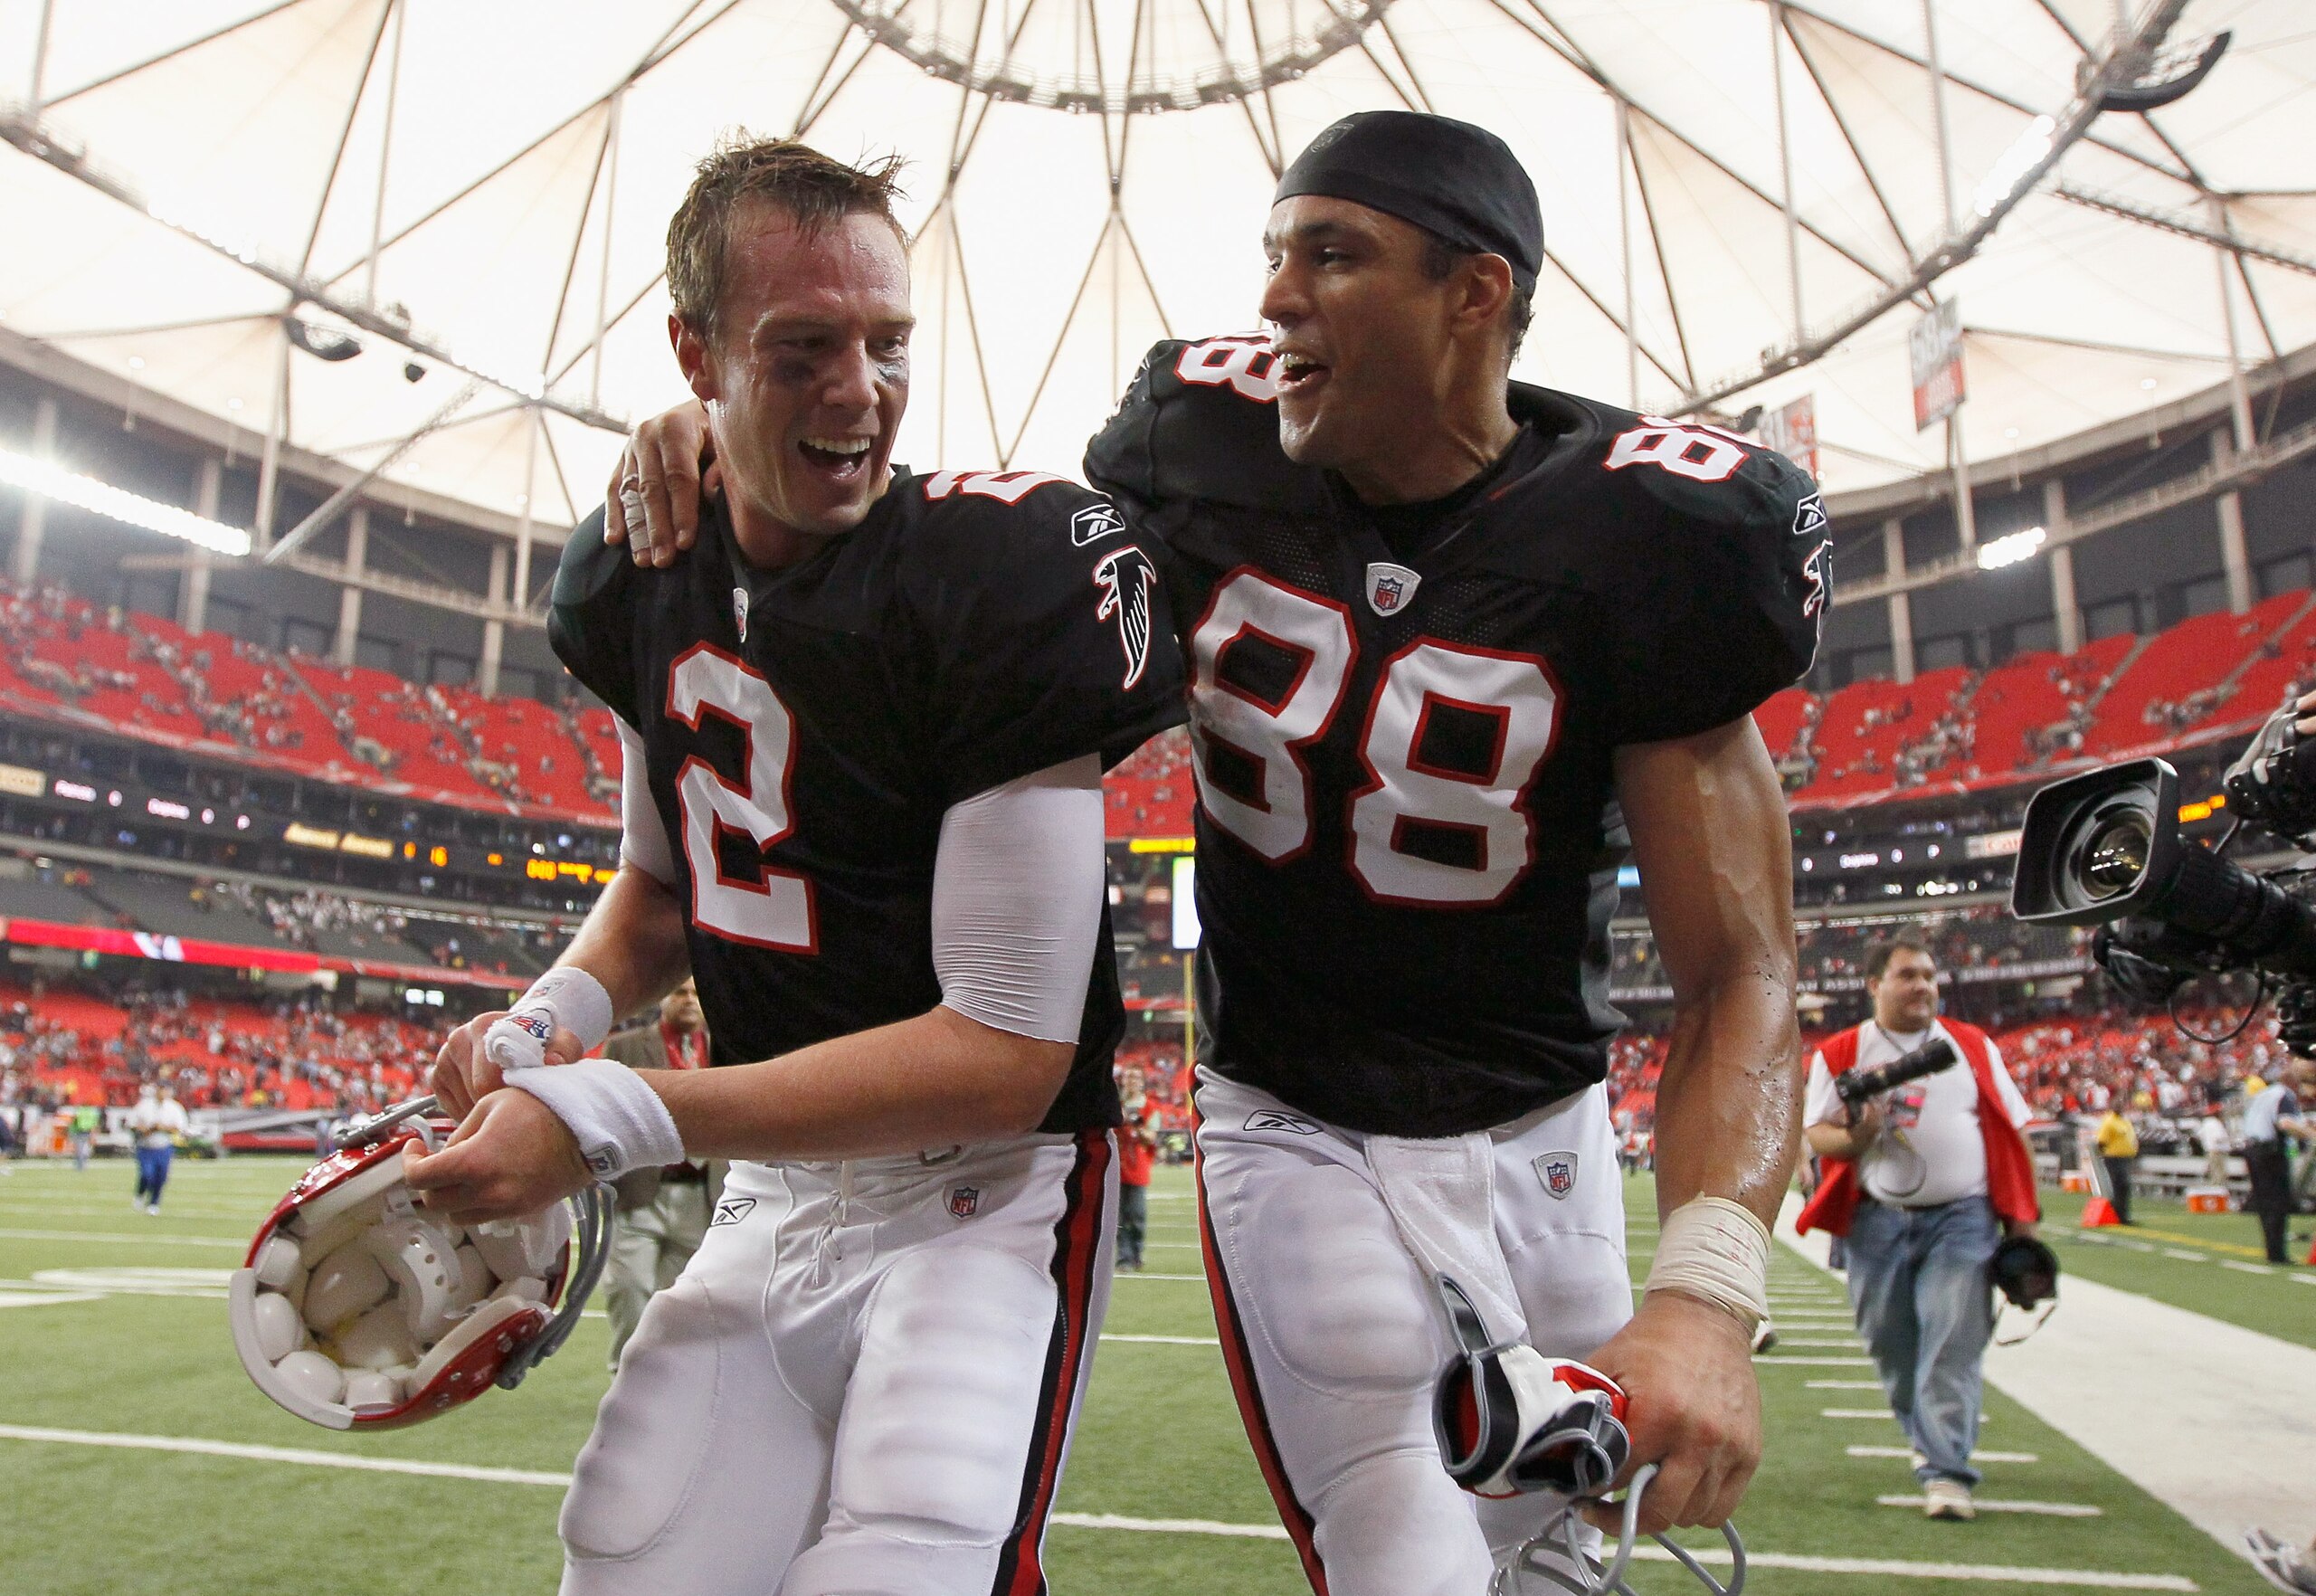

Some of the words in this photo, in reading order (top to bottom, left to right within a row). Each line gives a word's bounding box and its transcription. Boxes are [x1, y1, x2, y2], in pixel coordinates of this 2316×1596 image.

[1376, 592, 1399, 608] NFL
[1188, 565, 1563, 907] 88
[666, 641, 818, 955] 2
[1552, 1175, 1571, 1190] NFL
[953, 1199, 974, 1213] NFL
